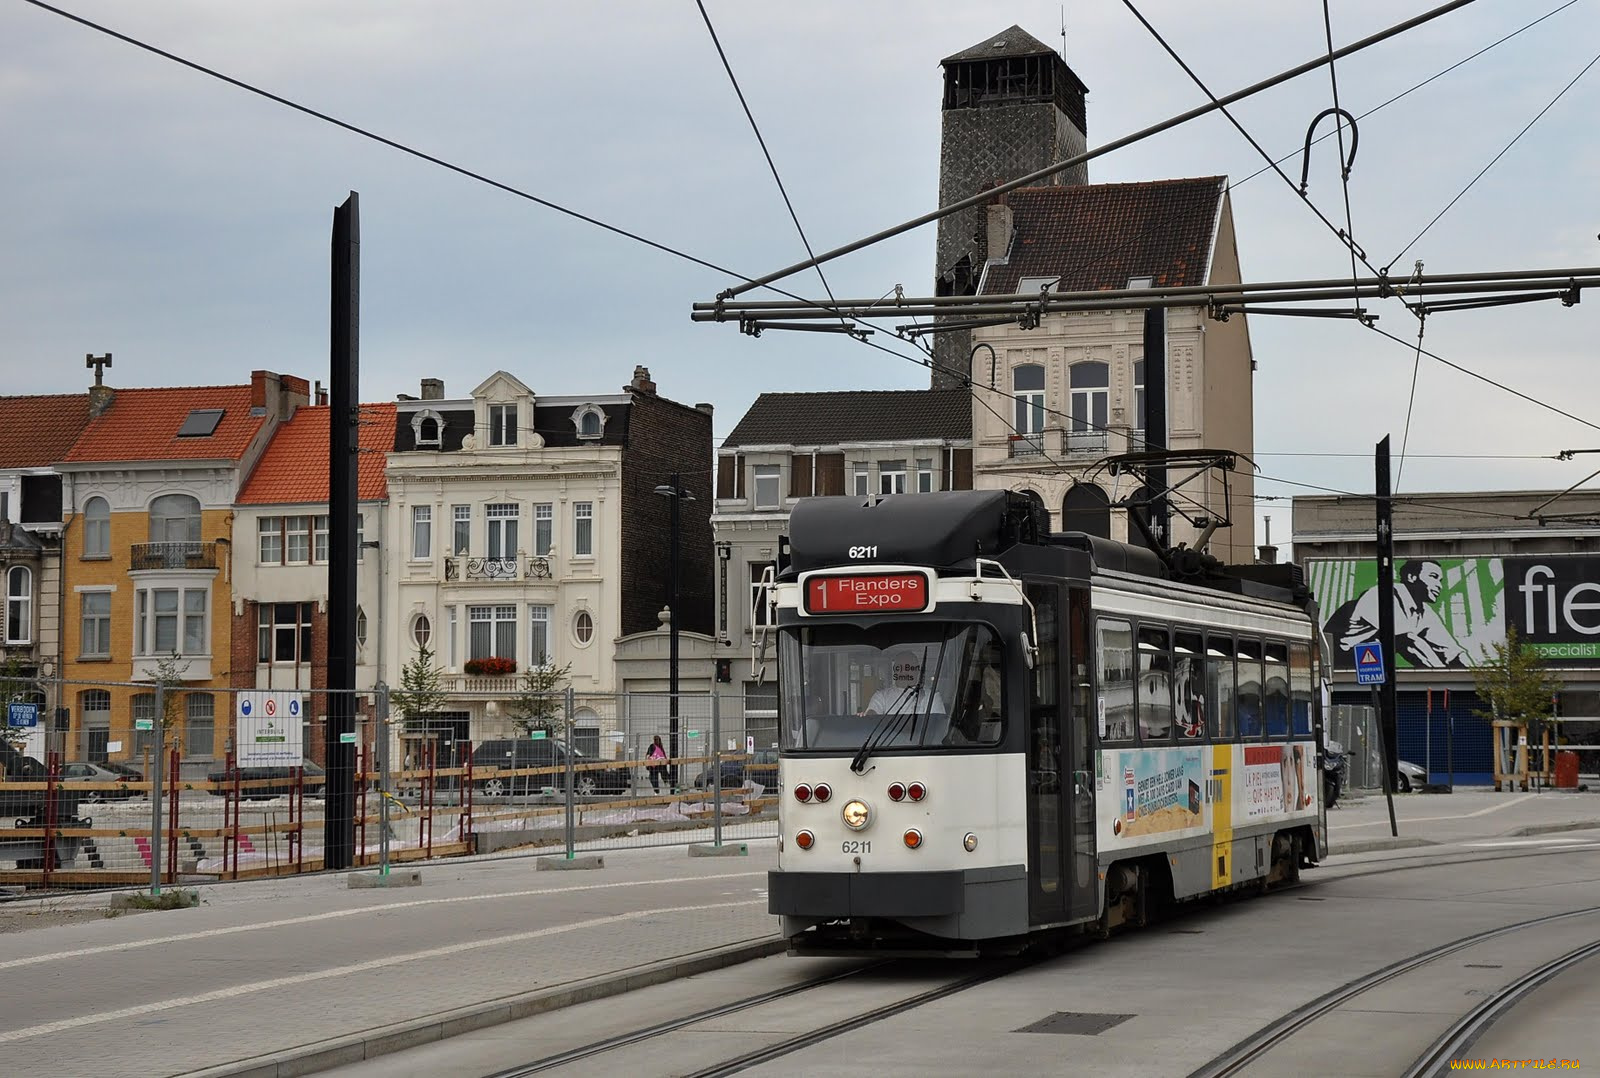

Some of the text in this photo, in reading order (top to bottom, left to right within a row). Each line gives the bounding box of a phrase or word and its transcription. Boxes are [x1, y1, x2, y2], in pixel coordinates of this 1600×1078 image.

[848, 545, 879, 559] 6211
[817, 577, 918, 609] 1 Flanders
[855, 592, 902, 607] Expo
[1518, 564, 1600, 635] fie
[1360, 674, 1383, 682] TRAM
[842, 841, 871, 853] 6211
